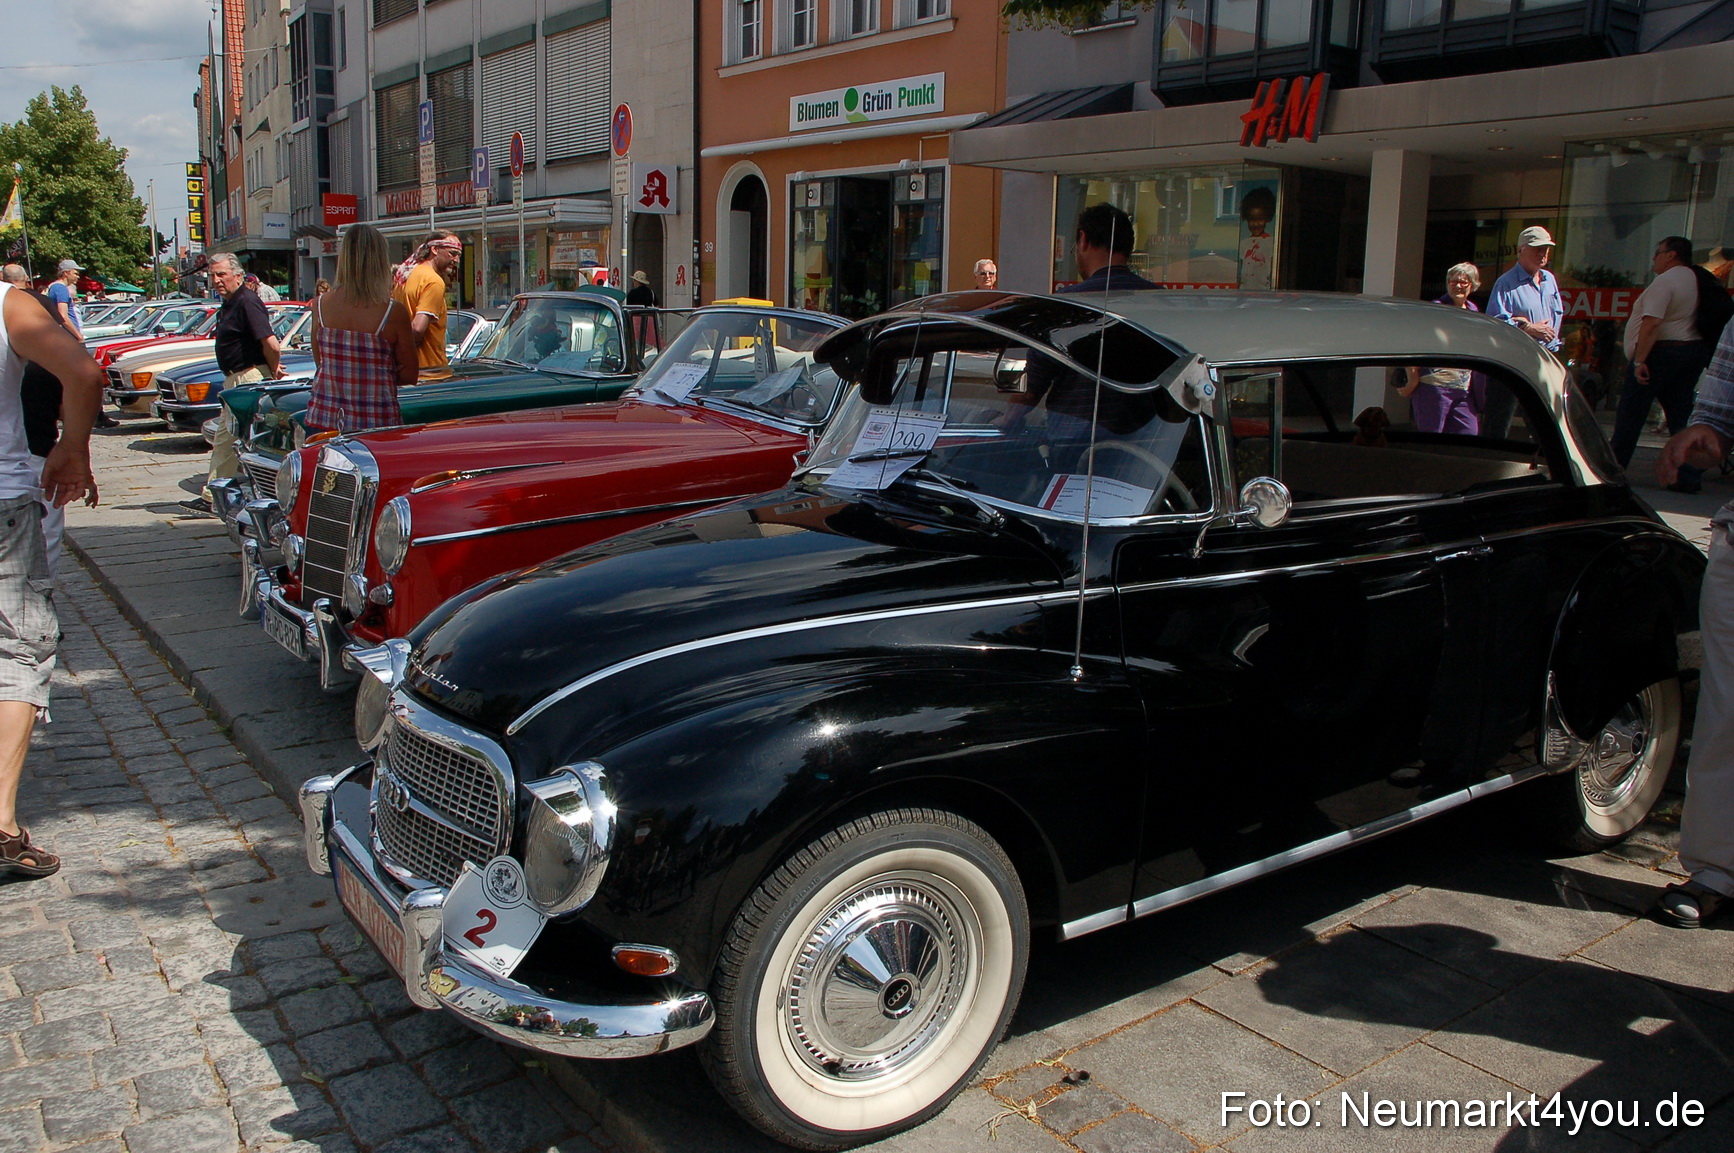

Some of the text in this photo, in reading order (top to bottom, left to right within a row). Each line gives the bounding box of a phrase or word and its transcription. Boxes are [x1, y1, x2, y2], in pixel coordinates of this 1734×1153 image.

[797, 83, 935, 122] Blumen Grün Punkt
[1239, 72, 1330, 147] H&M
[187, 163, 203, 240] HOTEL
[325, 205, 356, 216] ESPRIT
[704, 241, 714, 253] 39
[1559, 291, 1631, 318] SALE
[463, 908, 498, 948] 2
